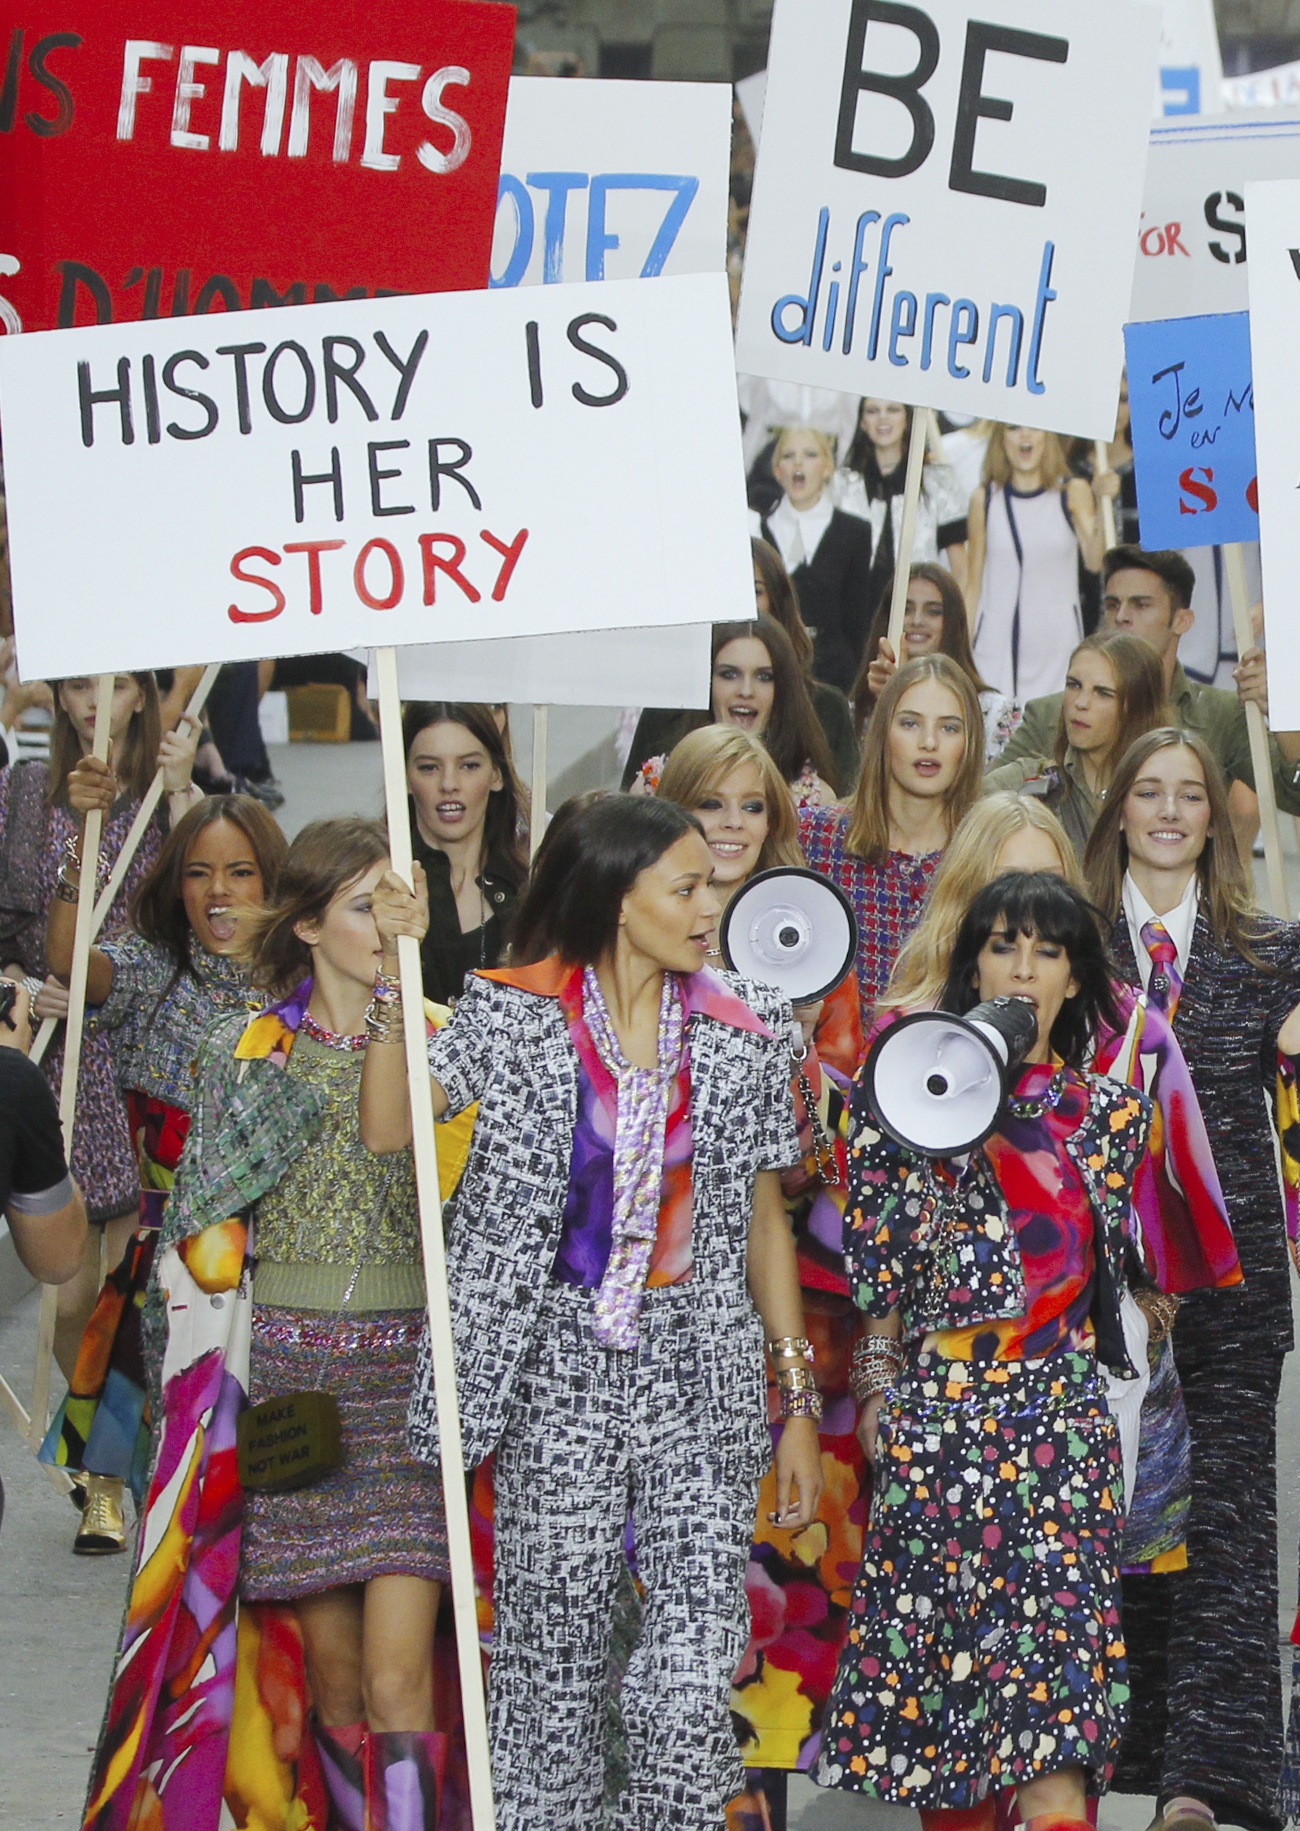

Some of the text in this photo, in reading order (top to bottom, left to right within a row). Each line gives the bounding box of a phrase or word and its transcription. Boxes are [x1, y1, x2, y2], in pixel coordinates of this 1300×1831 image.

[116, 38, 472, 175] FEMMES
[833, 0, 1070, 207] BE
[770, 205, 1058, 395] different
[77, 311, 630, 448] HISTORY IS
[1151, 360, 1205, 441] Je
[290, 436, 482, 524] HER
[228, 528, 530, 625] STORY
[246, 1445, 311, 1477] NOT WAR
[256, 1403, 298, 1428] MAKE
